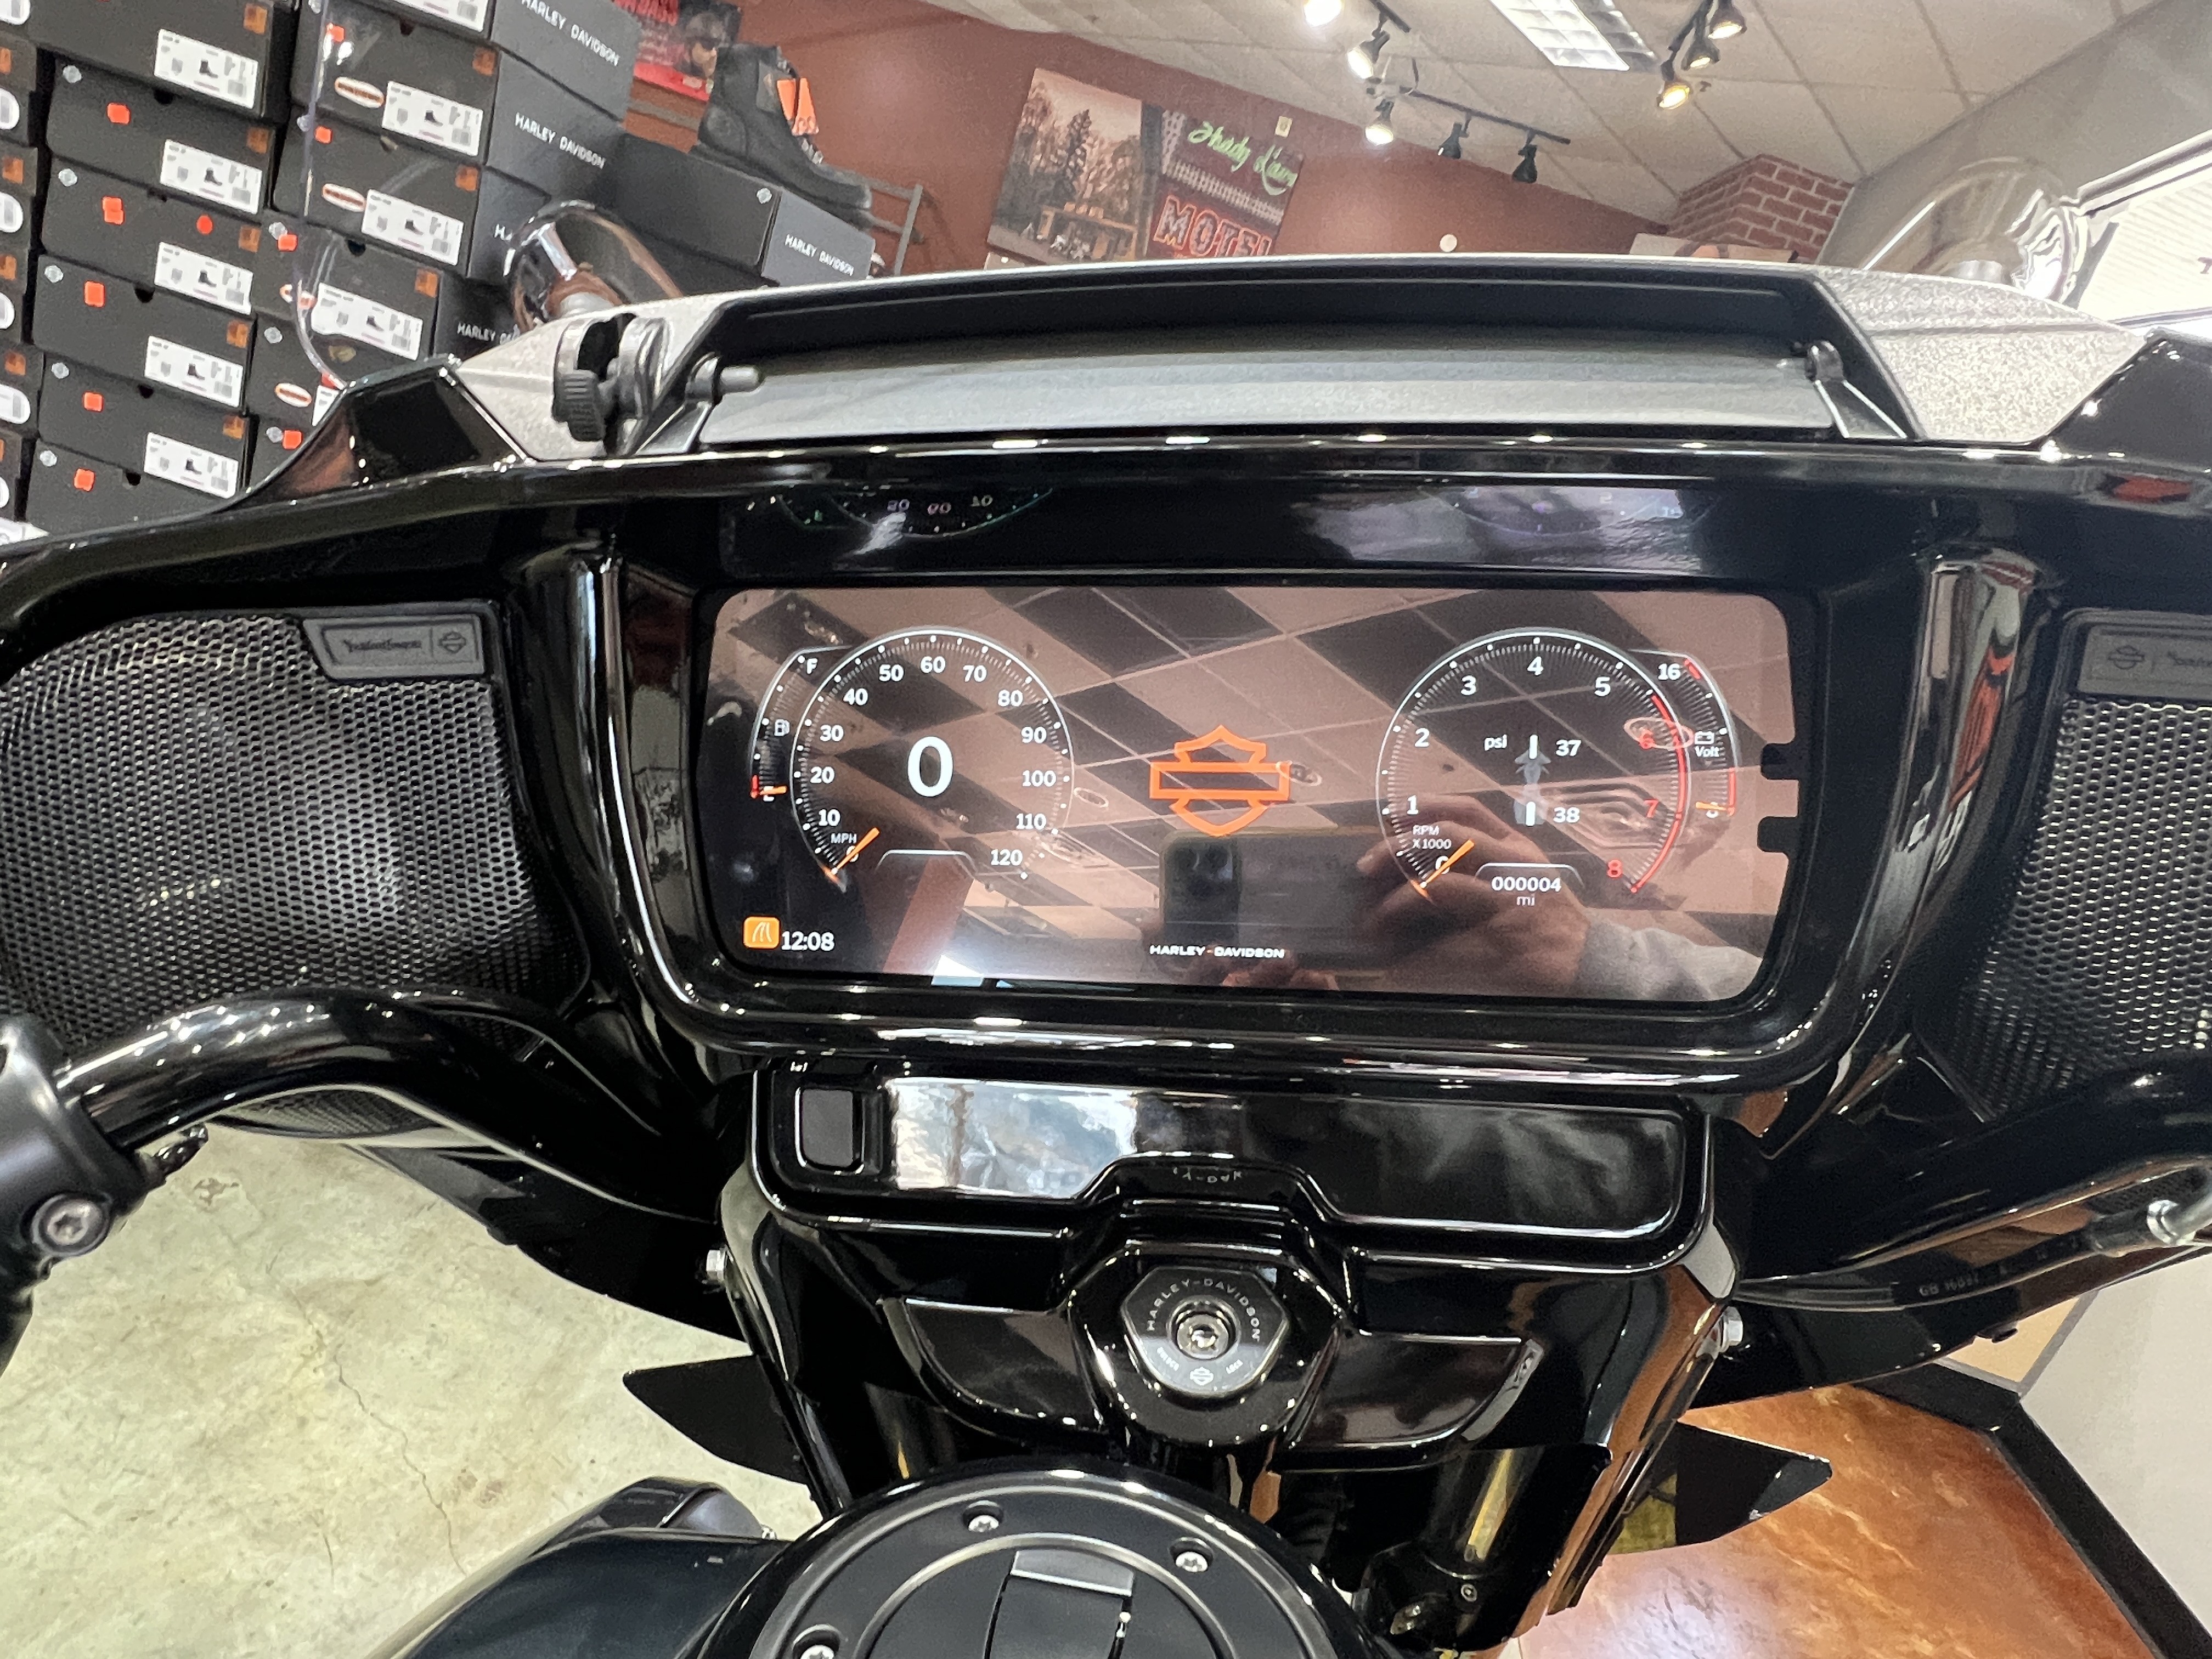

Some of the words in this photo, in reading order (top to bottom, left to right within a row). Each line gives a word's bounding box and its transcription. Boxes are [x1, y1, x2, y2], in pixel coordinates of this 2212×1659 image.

[571, 24, 620, 66] DAVIDSON
[515, 112, 556, 144] HARLEY
[559, 136, 607, 170] DAVIDSON
[785, 234, 817, 257] HARLEY
[819, 250, 855, 276] DAVIDSON
[806, 658, 818, 674] F
[879, 664, 904, 682] 50
[921, 656, 946, 674] 60
[963, 665, 987, 682] 70
[1527, 656, 1544, 675] 4
[1658, 663, 1681, 680] 16
[1460, 675, 1477, 696] 3
[1594, 676, 1611, 696] 5
[843, 688, 868, 706] 40
[997, 690, 1023, 707] 80
[820, 724, 844, 742] 30
[1021, 726, 1047, 744] 90
[1414, 727, 1430, 747] 2
[1485, 734, 1508, 751] psi
[1556, 740, 1582, 757] 37
[1695, 746, 1719, 757] Volt
[810, 766, 835, 783] 20
[907, 736, 953, 797] 0
[1022, 770, 1057, 787] 100
[1407, 795, 1419, 815] 1
[1644, 799, 1659, 818] 7
[819, 809, 840, 826] 10
[1016, 813, 1047, 830] 110
[1553, 806, 1581, 823] 38
[831, 833, 857, 844] MPH
[1412, 825, 1440, 836] RPM
[991, 849, 1023, 866] 120
[1607, 859, 1622, 879] 8
[1491, 876, 1561, 892] 000004
[1516, 893, 1535, 906] mi
[781, 931, 835, 951] 12:08
